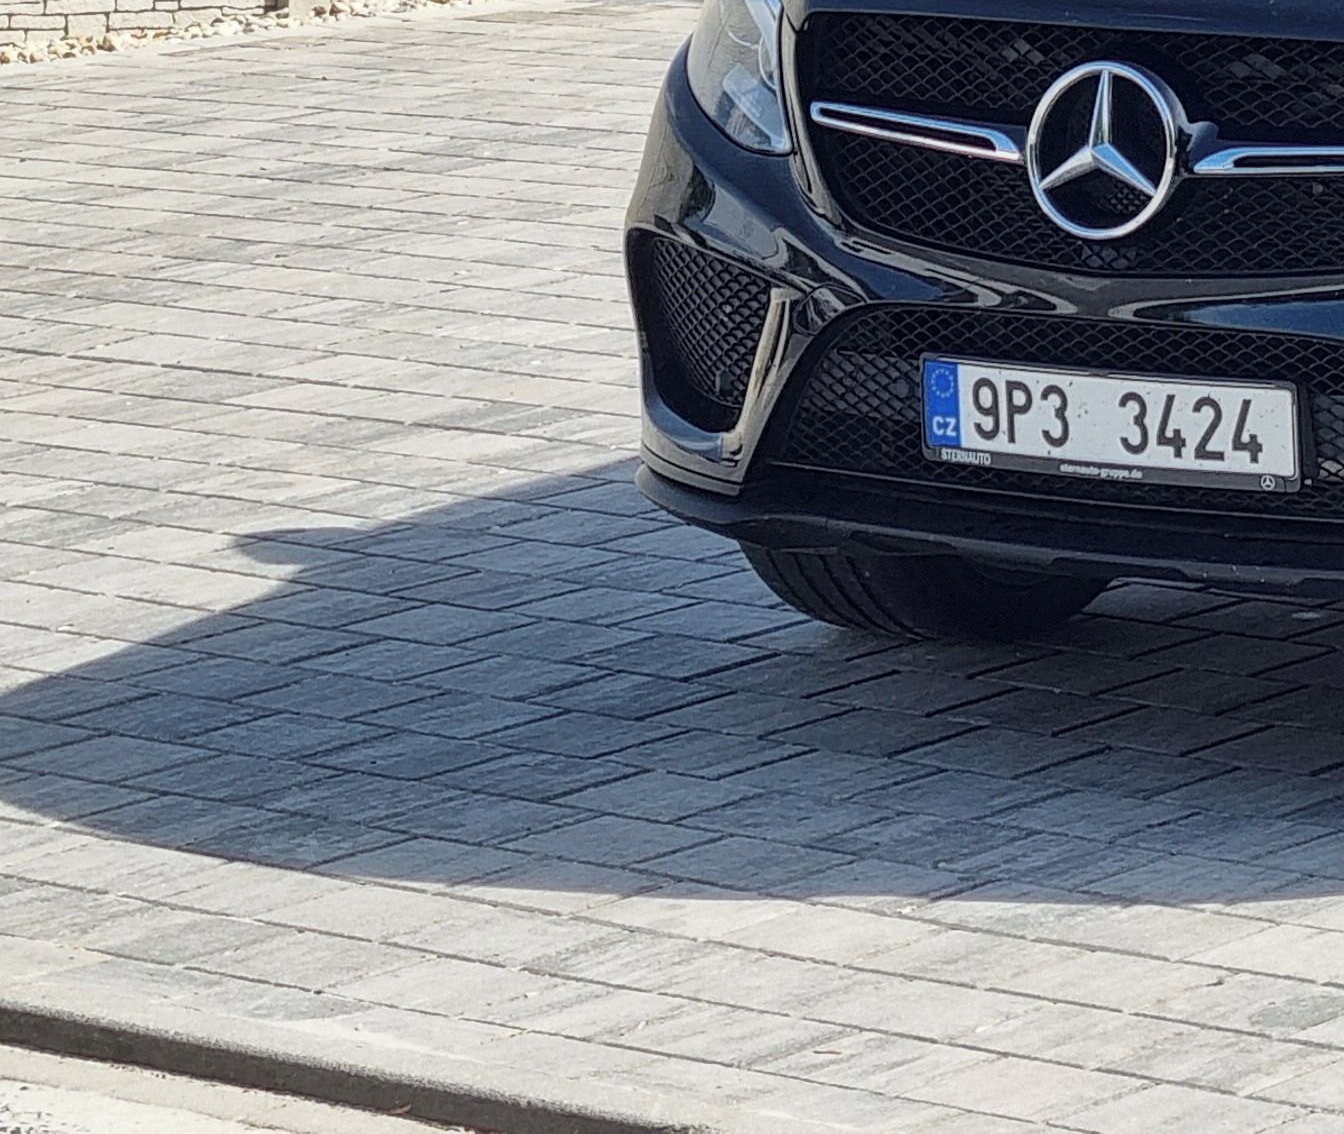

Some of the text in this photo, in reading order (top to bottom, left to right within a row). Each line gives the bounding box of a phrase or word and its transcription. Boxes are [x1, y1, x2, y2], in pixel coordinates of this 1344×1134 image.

[932, 416, 957, 437] CZ
[972, 377, 1263, 464] 9P3 3424
